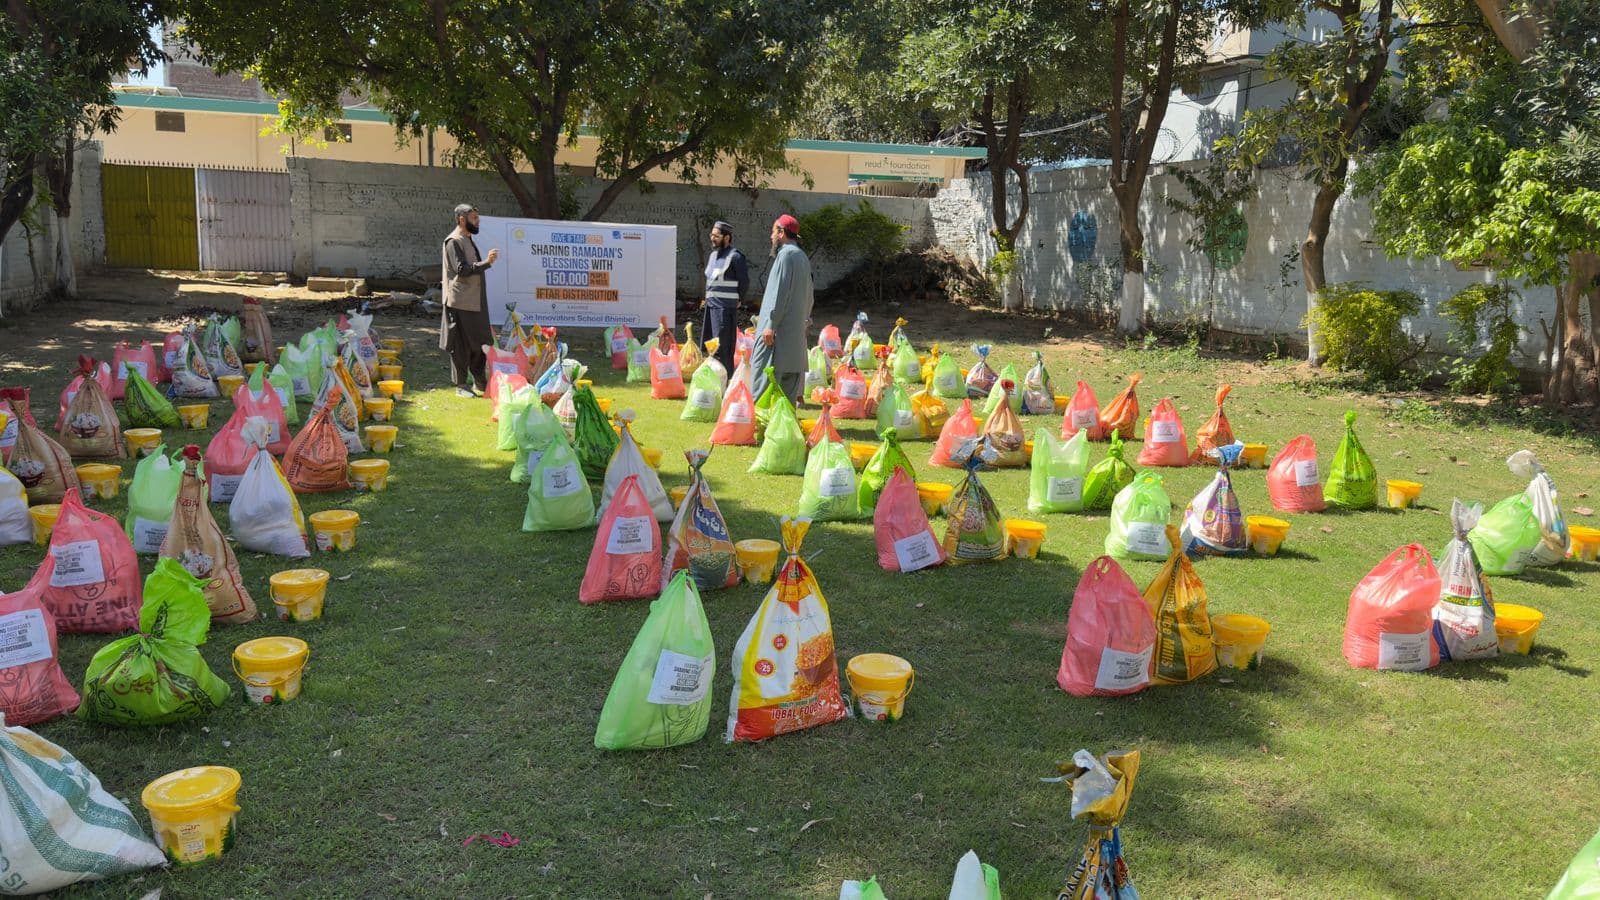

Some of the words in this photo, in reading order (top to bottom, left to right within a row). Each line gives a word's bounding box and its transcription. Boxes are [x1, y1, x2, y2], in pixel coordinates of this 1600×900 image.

[864, 160, 882, 168] read
[890, 161, 930, 170] foundation
[531, 244, 571, 256] SHARING
[572, 246, 624, 259] RAMADAN'S
[542, 257, 589, 270] BLESSINGS
[591, 259, 614, 271] WITH
[548, 271, 588, 286] 150,000
[536, 288, 560, 300] IFTAR
[562, 289, 619, 301] DISTRIBUTION
[577, 314, 603, 322] School
[605, 315, 636, 323] Bhimber
[1161, 638, 1175, 669] Mills
[772, 706, 798, 720] IQBAL
